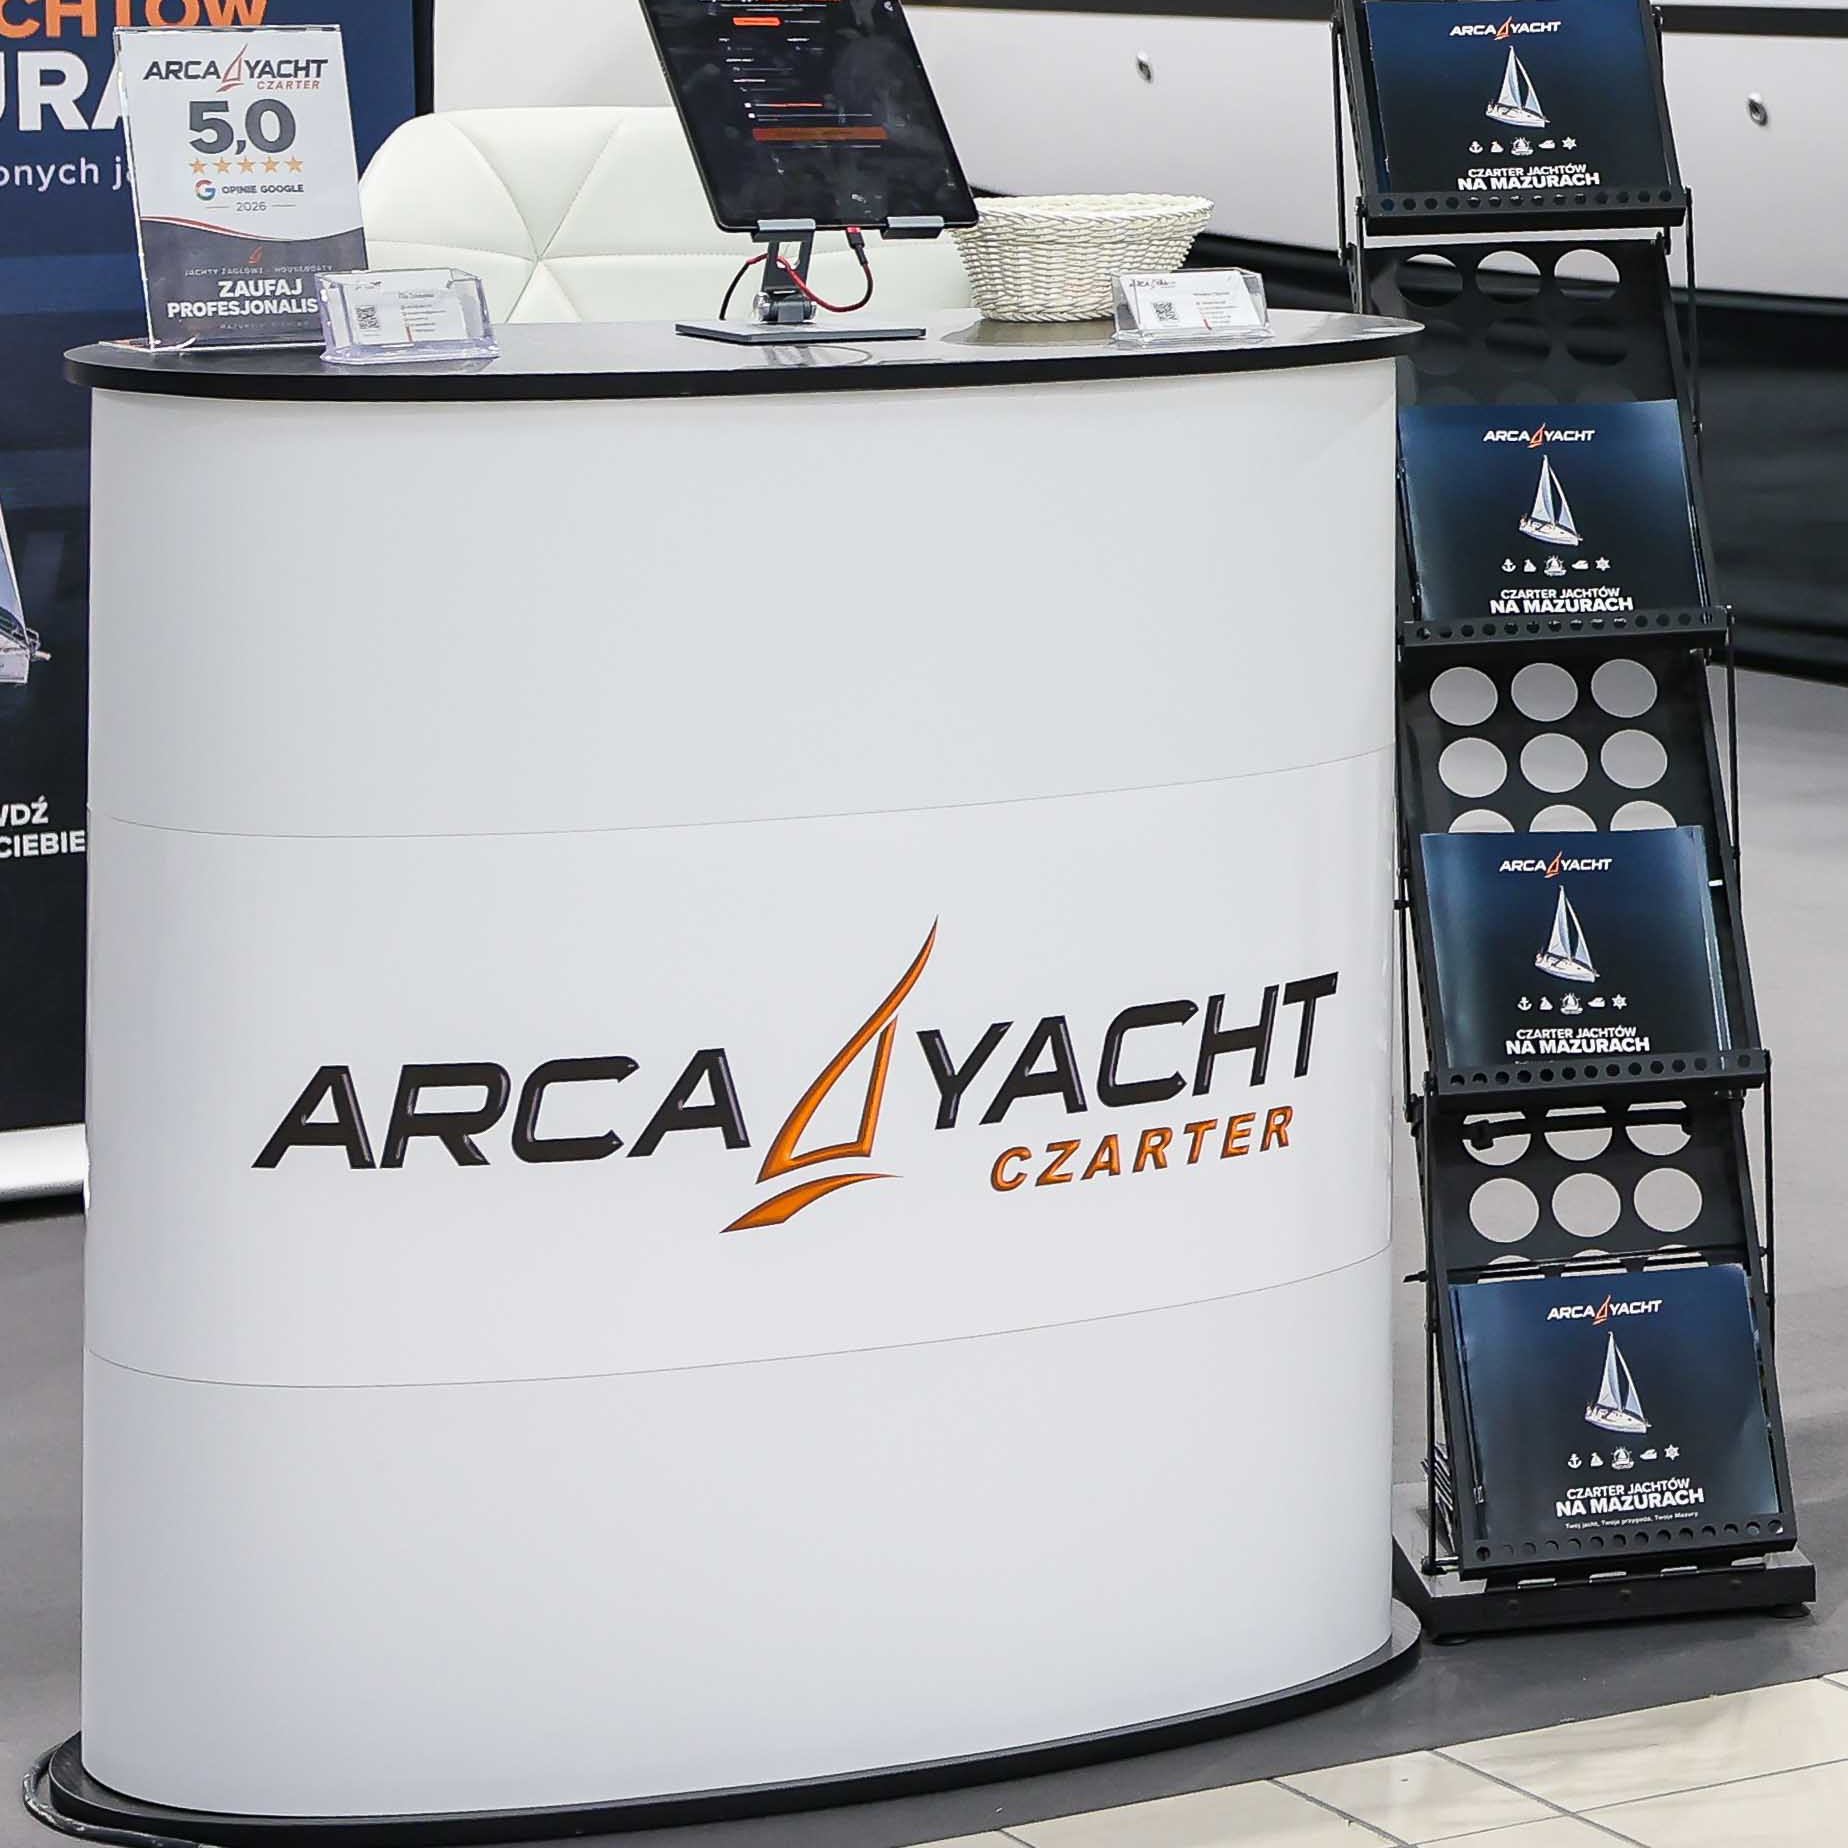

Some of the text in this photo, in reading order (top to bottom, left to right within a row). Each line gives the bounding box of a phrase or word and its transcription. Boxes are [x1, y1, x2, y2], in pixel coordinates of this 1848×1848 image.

[1449, 21, 1562, 37] ARCA YACHT
[143, 59, 328, 80] ARCA YACHT
[256, 80, 320, 90] CZARTER
[189, 98, 296, 155] 5,0
[1468, 163, 1587, 178] CZARTER JACHTÓW
[221, 183, 304, 194] OPINIE GOOGLE
[1457, 172, 1600, 191] NA MAZURACH
[217, 278, 303, 299] ZAUFAJ
[1483, 430, 1596, 442] ARCA YACHT
[1500, 586, 1620, 600] CZARTER JACHTÓW
[1490, 597, 1634, 614] NA MAZURACH
[1499, 858, 1613, 872] ARCA YACHT
[1516, 1025, 1637, 1040] CZARTER JACHTÓW
[1506, 1036, 1650, 1055] NA MAZURACH
[251, 971, 1339, 1169] ARCA YACHT
[989, 1105, 1294, 1192] CZARTER
[1546, 1299, 1663, 1321] ARCA YACHT
[1566, 1477, 1690, 1500] CZARTER JACHTÓW
[1556, 1487, 1705, 1517] NA MAZURACH
